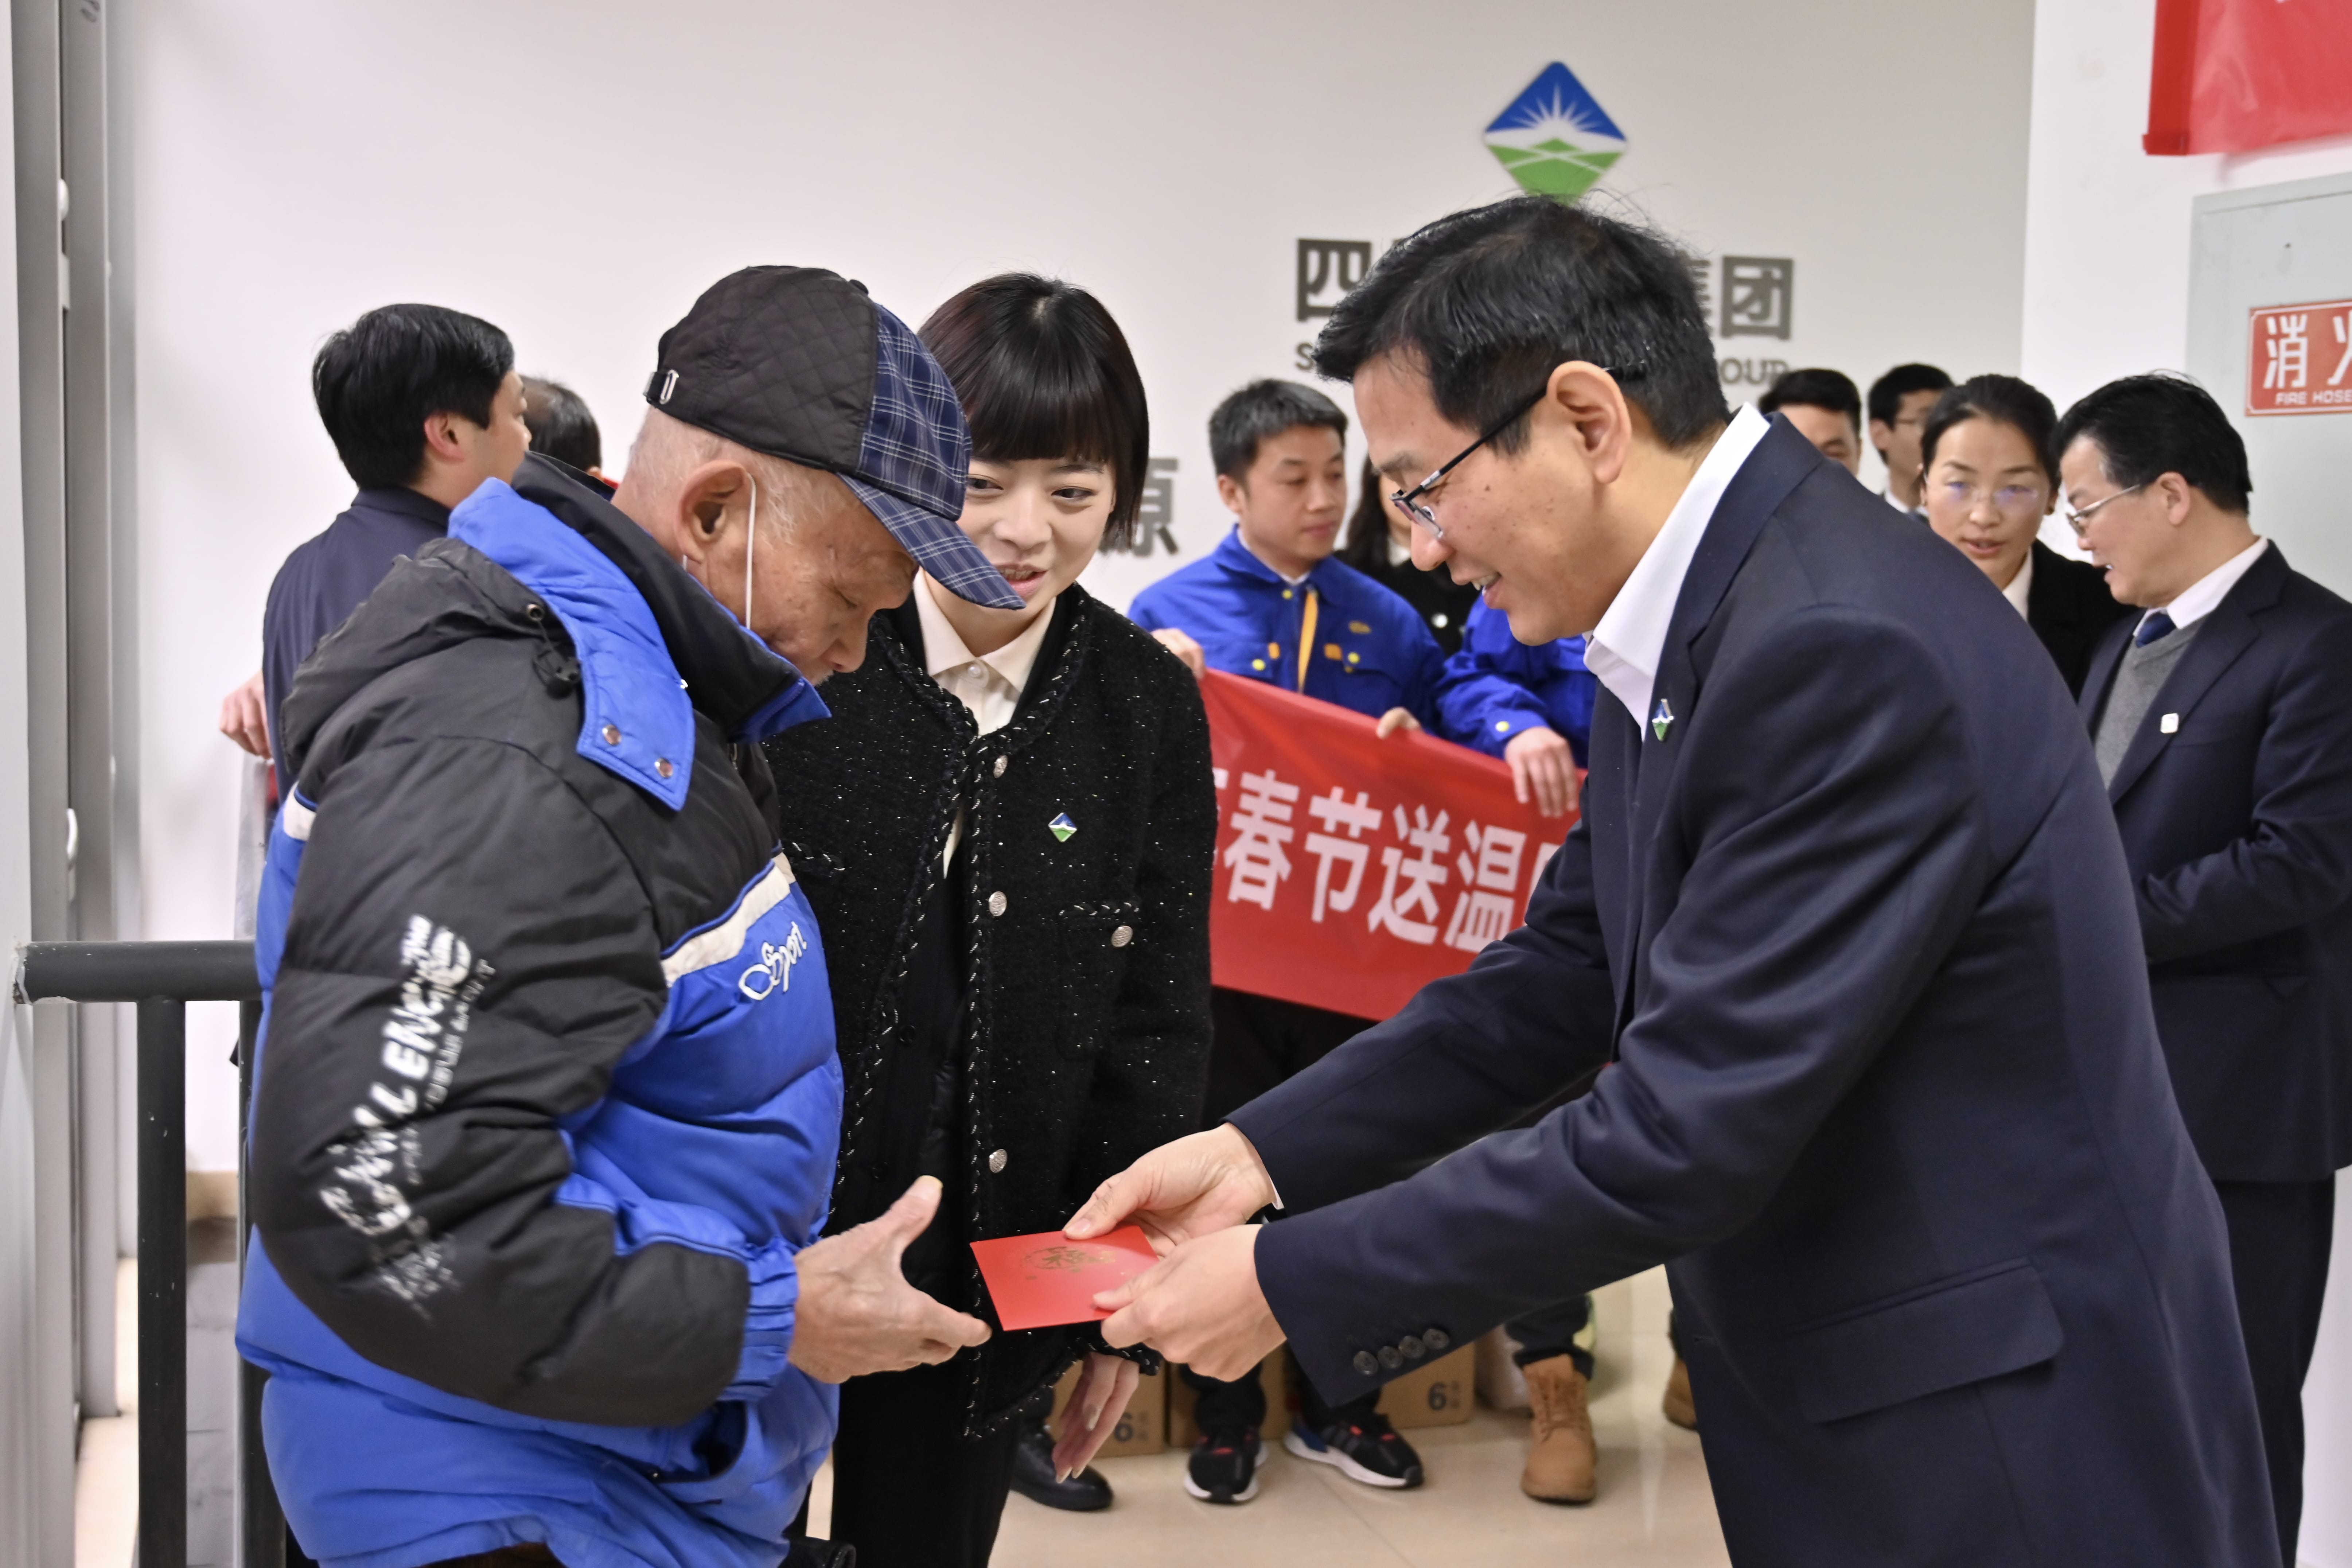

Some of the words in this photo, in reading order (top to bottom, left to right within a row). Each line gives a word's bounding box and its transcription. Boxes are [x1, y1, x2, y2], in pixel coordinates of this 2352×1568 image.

[2275, 392, 2307, 405] FIRE
[2312, 389, 2352, 404] HOSE
[1212, 767, 1561, 954] 春节送温
